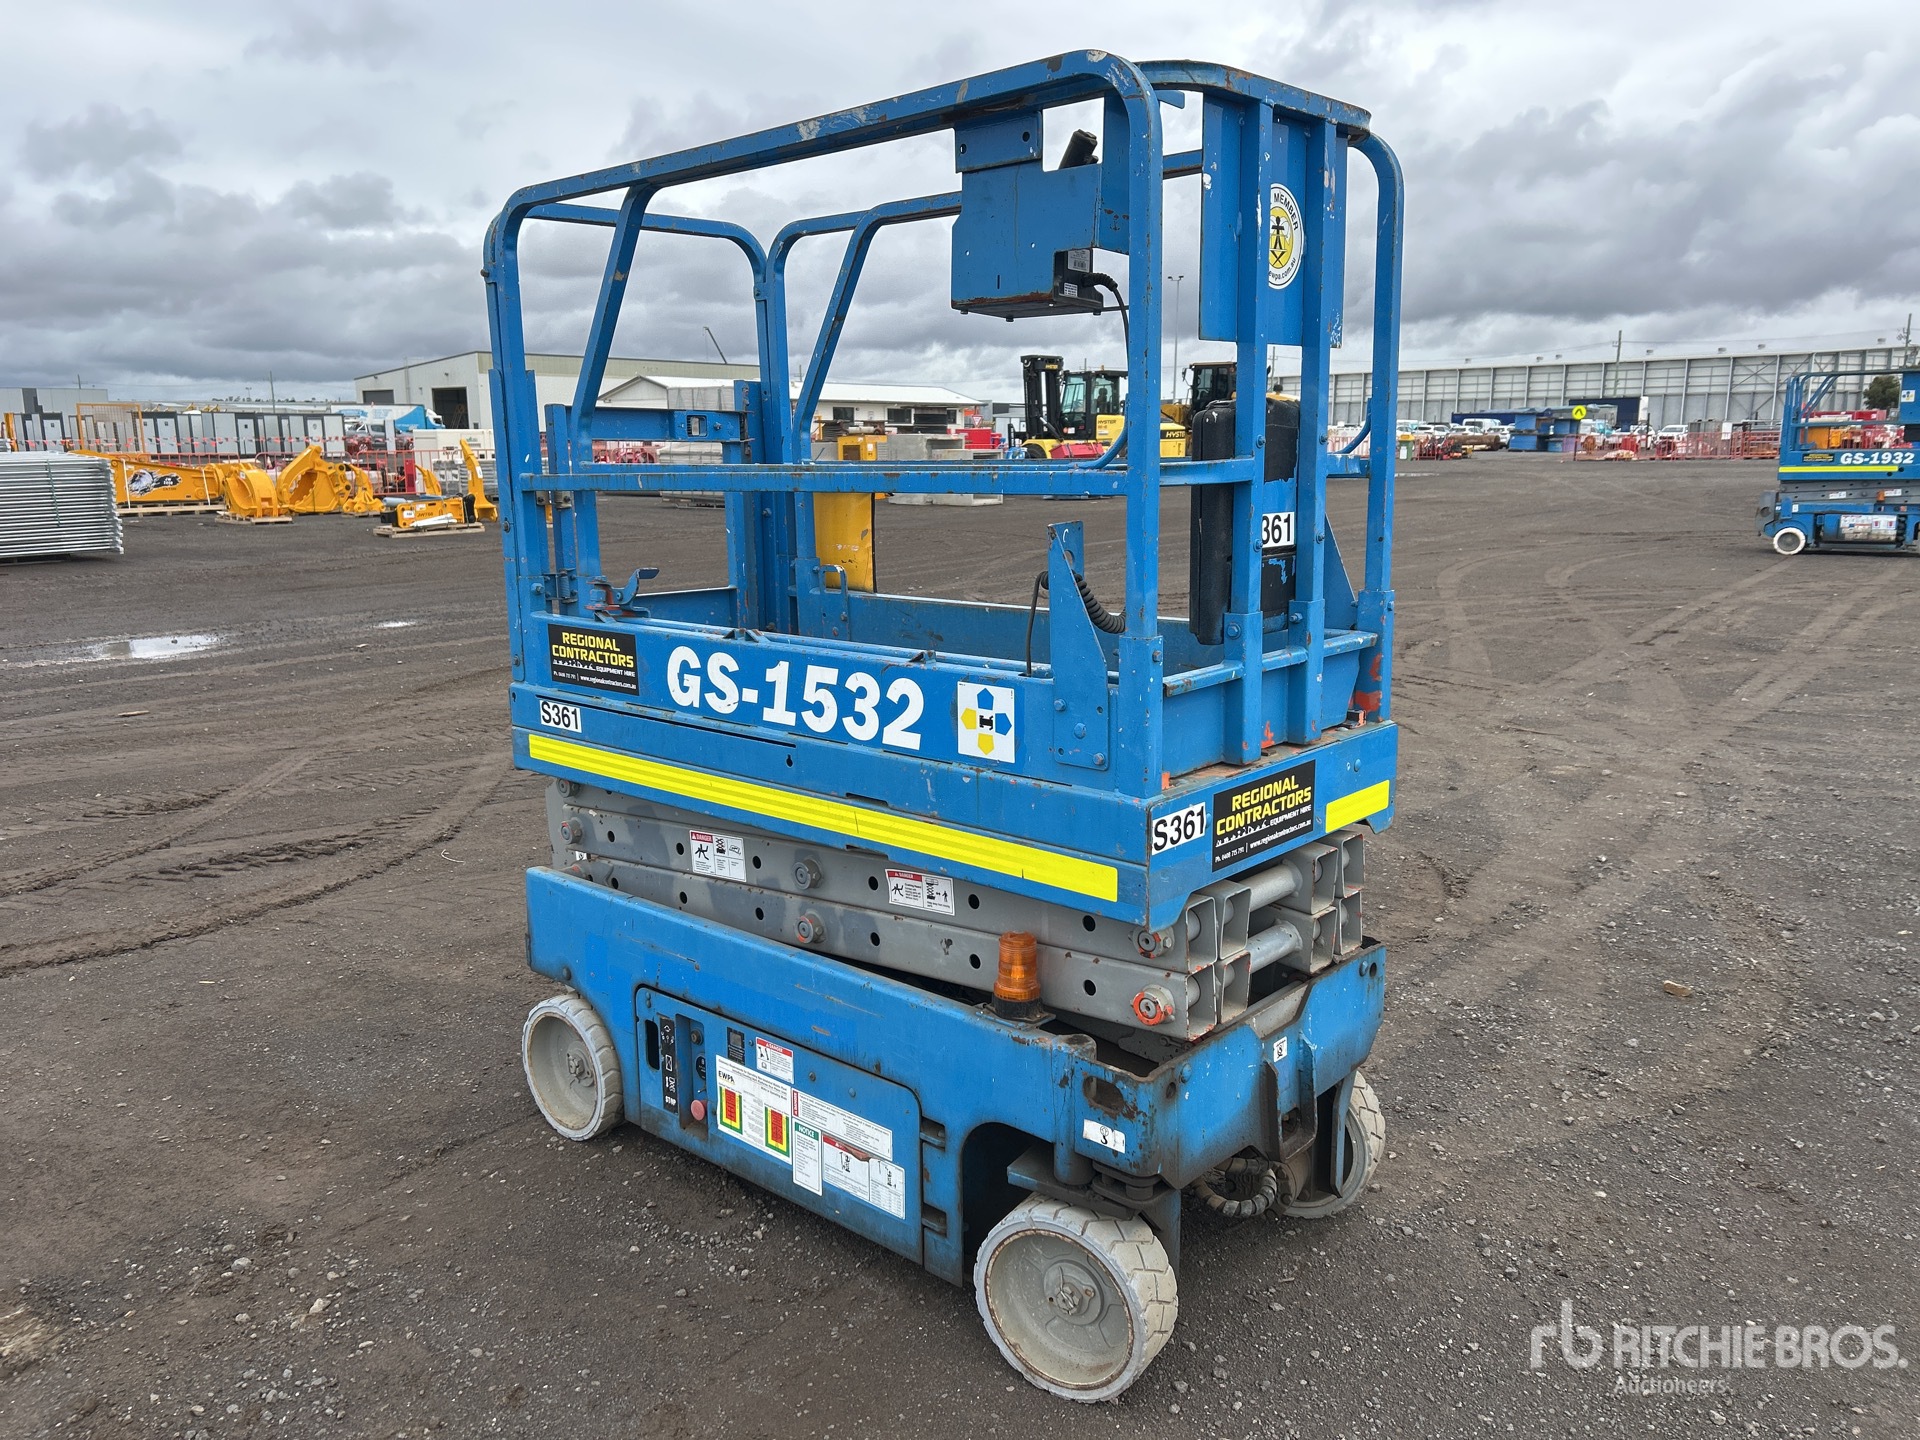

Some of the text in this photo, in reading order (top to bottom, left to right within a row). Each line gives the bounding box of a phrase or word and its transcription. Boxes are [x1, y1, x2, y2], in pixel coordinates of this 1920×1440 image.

[1273, 192, 1298, 231] MEMBER
[1840, 452, 1915, 464] GS-1932
[562, 631, 620, 652] REGIONAL
[552, 644, 634, 668] CONTRACTORS
[595, 665, 636, 678] EQUIPMENT HIRE
[667, 645, 925, 751] GS-1532
[541, 700, 579, 730] S361
[1231, 775, 1299, 812] REGIONAL
[1216, 787, 1312, 836] CONTRACTORS
[1269, 804, 1312, 826] EQUIPMENT HIRE
[696, 833, 712, 842] DANGER
[1153, 805, 1205, 852] S361
[769, 1044, 783, 1053] DANGER
[718, 1070, 735, 1083] EWPA
[798, 1124, 815, 1139] NOTICE
